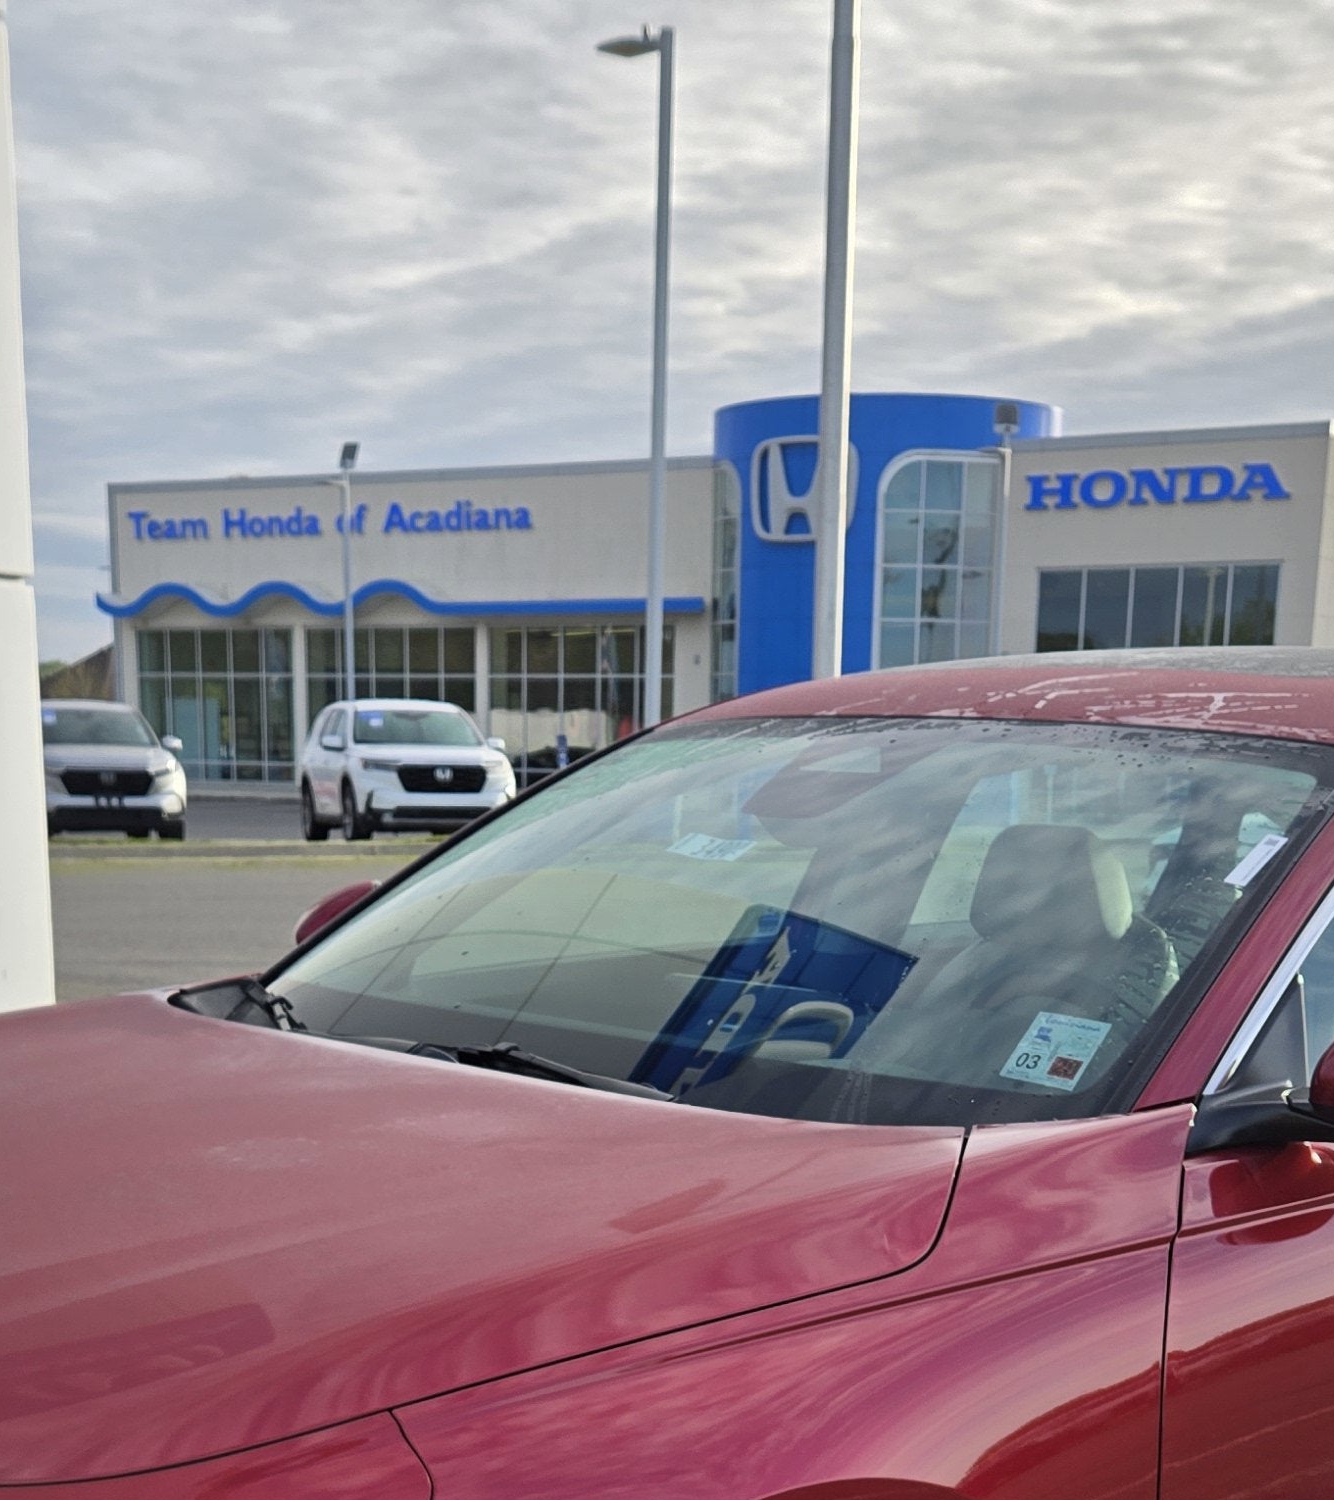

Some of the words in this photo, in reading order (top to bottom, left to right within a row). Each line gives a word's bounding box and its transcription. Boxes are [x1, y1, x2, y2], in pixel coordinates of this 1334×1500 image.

[1025, 462, 1291, 511] HONDA
[128, 511, 209, 540] Team
[223, 507, 321, 538] Honda
[384, 500, 533, 534] Acadiana
[1015, 1053, 1042, 1070] 03
